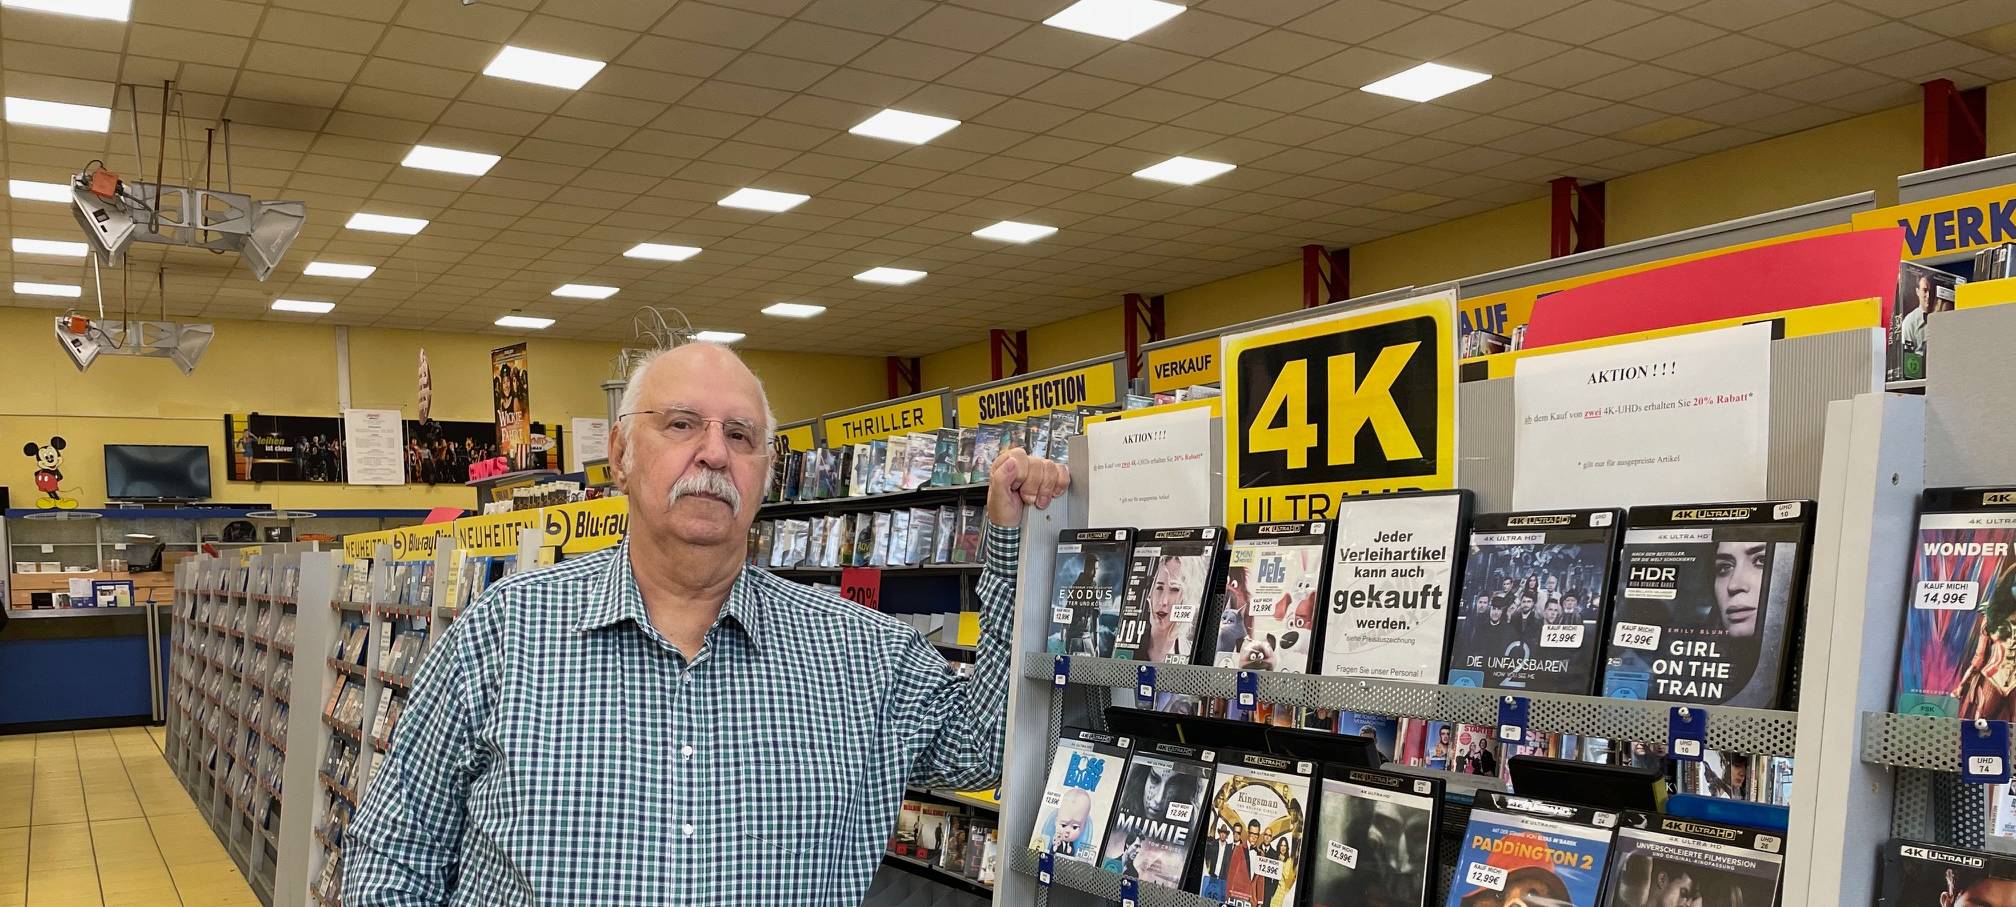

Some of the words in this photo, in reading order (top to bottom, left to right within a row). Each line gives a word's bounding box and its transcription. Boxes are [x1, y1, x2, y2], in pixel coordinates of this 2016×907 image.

[1155, 354, 1212, 379] VERKAUF
[1587, 365, 1649, 384] AKTION
[979, 386, 1030, 421] SCIENCE
[1032, 374, 1086, 410] FICTION
[1249, 340, 1423, 469] 4K
[1534, 413, 1549, 423] dem
[1550, 411, 1568, 421] Kauf
[1584, 408, 1602, 419] zwei
[1603, 403, 1642, 415] 4K-UHDs
[1644, 401, 1676, 412] erhalten
[1678, 399, 1692, 408] Sie
[1693, 397, 1714, 406] 20%
[842, 408, 924, 439] THRILLER
[257, 436, 285, 446] leihen
[1122, 432, 1152, 445] AKTION
[274, 445, 293, 453] clever
[1986, 494, 2011, 503] 4K
[1674, 510, 1694, 518] 4K
[1374, 530, 1413, 543] Jeder
[1340, 546, 1447, 562] Verleihartikel
[1923, 542, 2009, 556] WONDER
[1354, 566, 1386, 578] kann
[1391, 565, 1424, 578] auch
[1630, 567, 1676, 581] HDR
[1059, 589, 1113, 600] EXODUS
[1333, 584, 1443, 614] gekauft
[1923, 593, 1968, 605] 14,99€
[1252, 604, 1272, 612] 12,99€
[1173, 611, 1191, 619] 12,99€
[1356, 617, 1410, 630] werden.
[1117, 620, 1146, 643] JOY
[1362, 635, 1416, 645] Preisauszeichnung
[1546, 633, 1577, 644] 12,99€
[1620, 633, 1653, 645] 12,99€
[1670, 640, 1720, 658] GIRL
[1336, 664, 1358, 674] Fragen
[1359, 665, 1370, 674] Sie
[1371, 667, 1388, 675] unser
[1390, 668, 1419, 677] Personal
[1466, 655, 1484, 668] DIE
[1487, 656, 1569, 673] UNFASSBAREN
[1652, 659, 1683, 675] ON
[1688, 661, 1731, 679] THE
[1656, 679, 1723, 699] TRAIN
[1681, 746, 1690, 754] 10
[1351, 772, 1362, 780] 4K
[1237, 792, 1278, 809] Kingsman
[1170, 809, 1188, 818] 12,99€
[1117, 812, 1189, 846] MUMIE
[1664, 821, 1683, 831] 4K
[1682, 838, 1707, 847] ULTRA
[1076, 848, 1095, 859] HDR
[1330, 849, 1353, 863] 12,99€
[1636, 841, 1703, 859] UNVERSCHLEIERTE
[1704, 853, 1757, 869] FILMVERSION
[1904, 848, 1924, 857] 4K
[1258, 863, 1279, 875] 12,99€
[1580, 855, 1594, 871] 2
[1472, 871, 1500, 885] 12,99€
